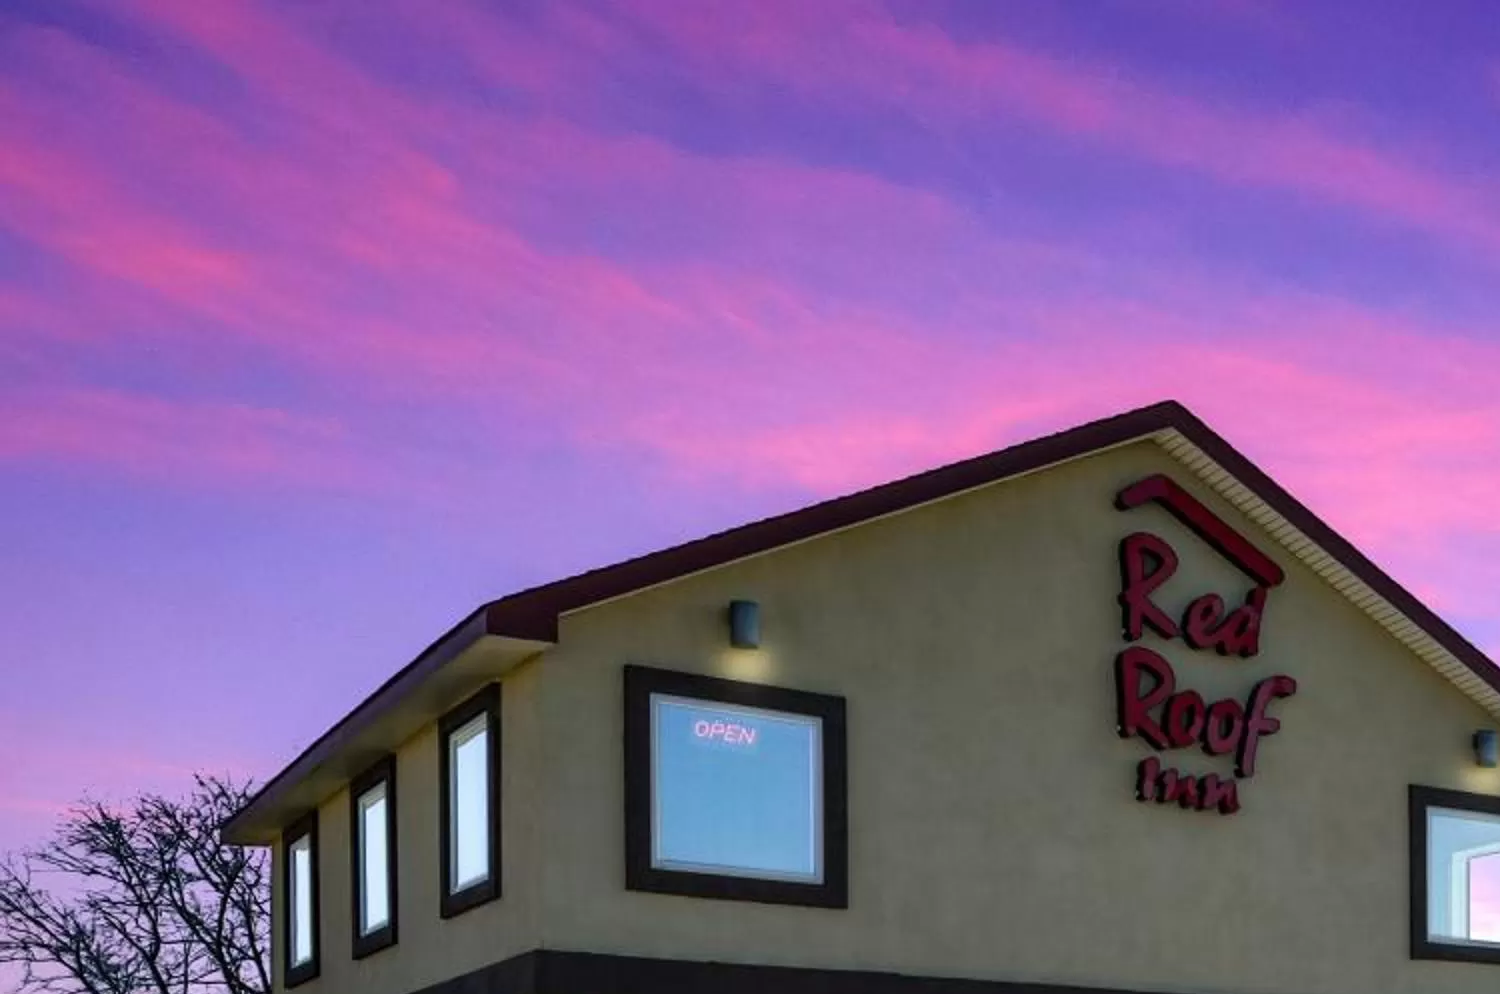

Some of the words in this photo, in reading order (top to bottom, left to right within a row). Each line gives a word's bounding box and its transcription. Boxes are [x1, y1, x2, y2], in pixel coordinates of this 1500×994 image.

[1117, 531, 1267, 657] Red
[694, 719, 757, 744] OPEN
[1115, 646, 1297, 779] Roof
[1136, 756, 1240, 815] Inn
